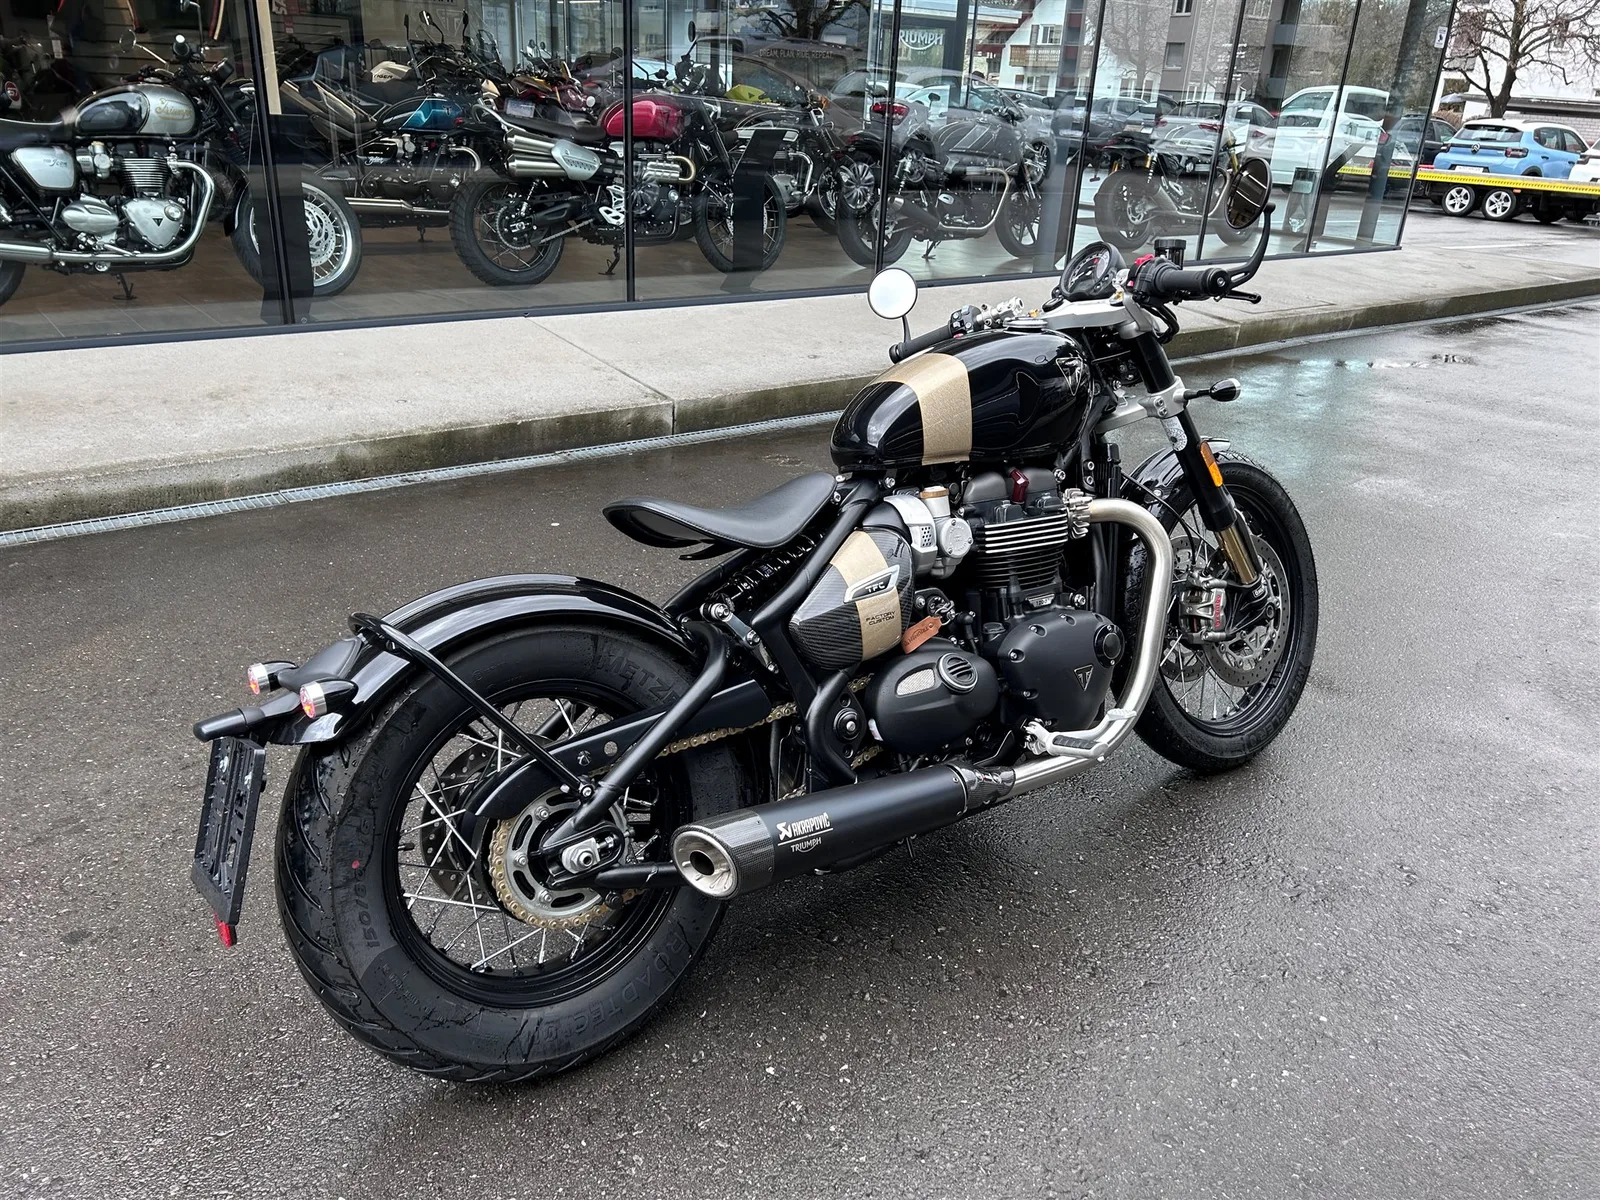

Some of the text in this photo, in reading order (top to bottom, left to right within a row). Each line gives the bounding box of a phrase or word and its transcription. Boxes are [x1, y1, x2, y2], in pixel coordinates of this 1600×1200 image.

[899, 29, 944, 50] RIUMPH
[865, 581, 886, 593] TFC
[865, 610, 896, 622] FACTORY
[868, 615, 895, 626] CUSTOM
[790, 836, 822, 853] TRIUMPH
